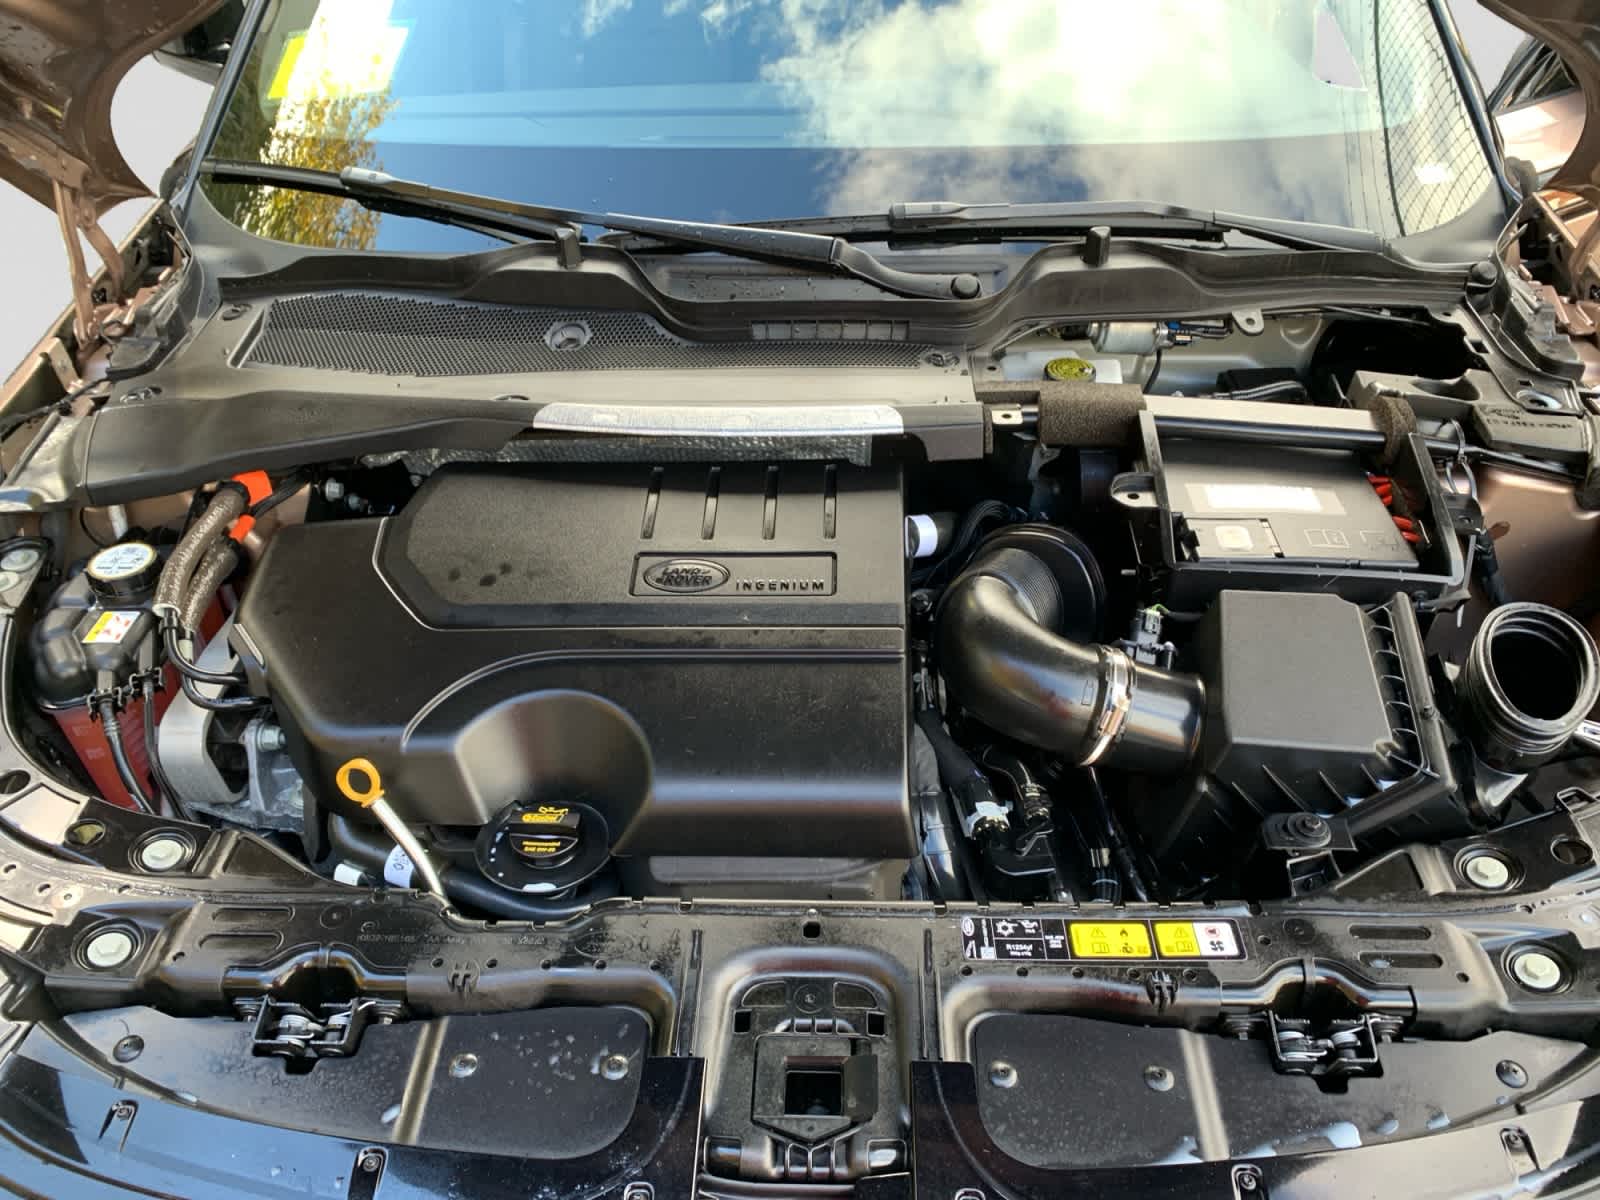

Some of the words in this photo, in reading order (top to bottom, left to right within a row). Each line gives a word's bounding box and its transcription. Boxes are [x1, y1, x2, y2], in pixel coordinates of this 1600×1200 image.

[662, 567, 704, 575] LAND
[663, 575, 713, 586] ROVER
[735, 580, 825, 591] INGENIUM
